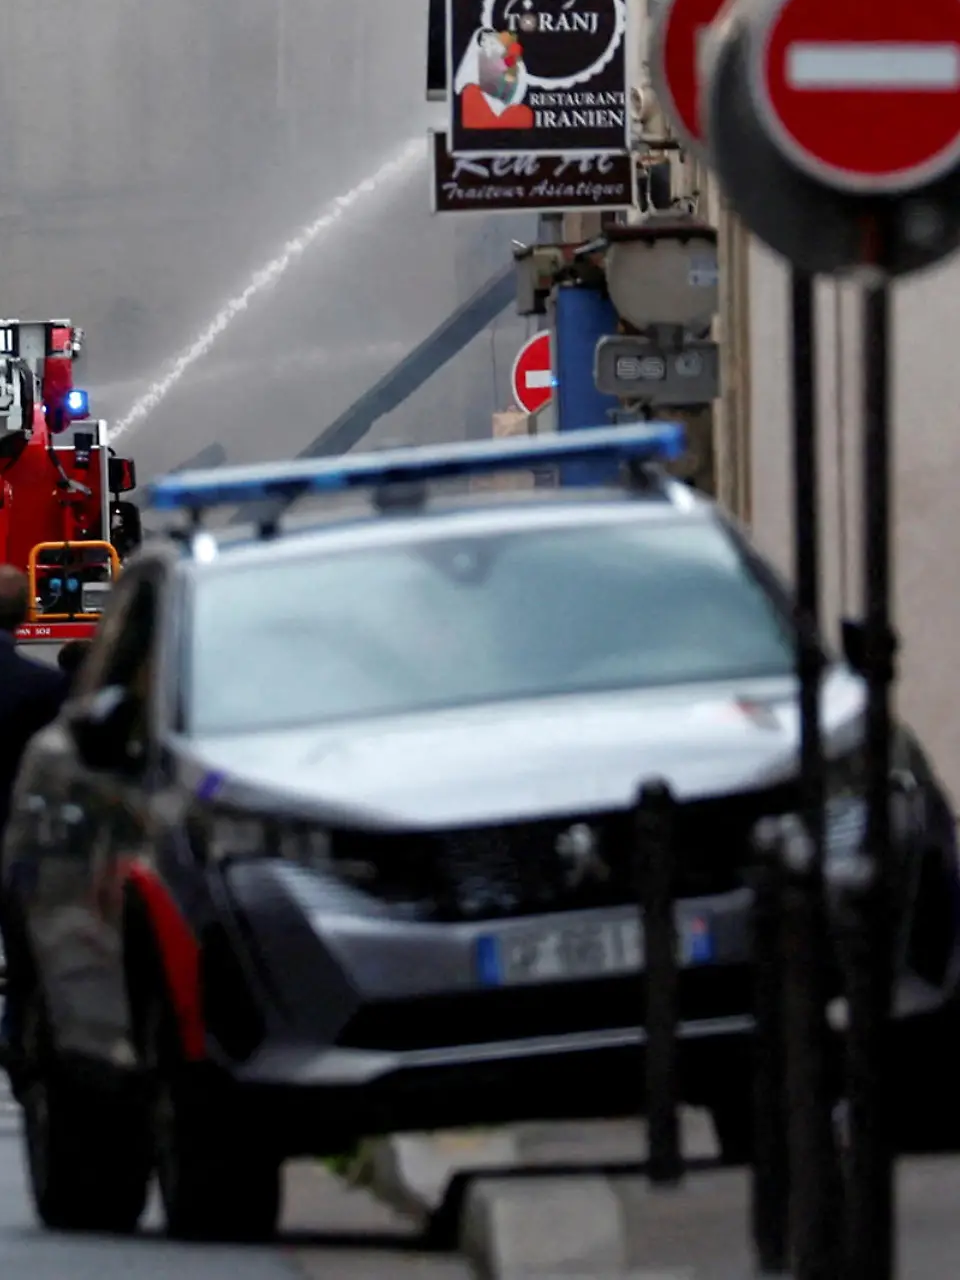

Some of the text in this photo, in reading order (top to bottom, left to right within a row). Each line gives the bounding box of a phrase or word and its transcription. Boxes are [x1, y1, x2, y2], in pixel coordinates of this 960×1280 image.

[529, 91, 625, 106] RESTAURANT
[535, 109, 624, 128] IRANIEN
[442, 178, 624, 201] Traiteur Asiatique
